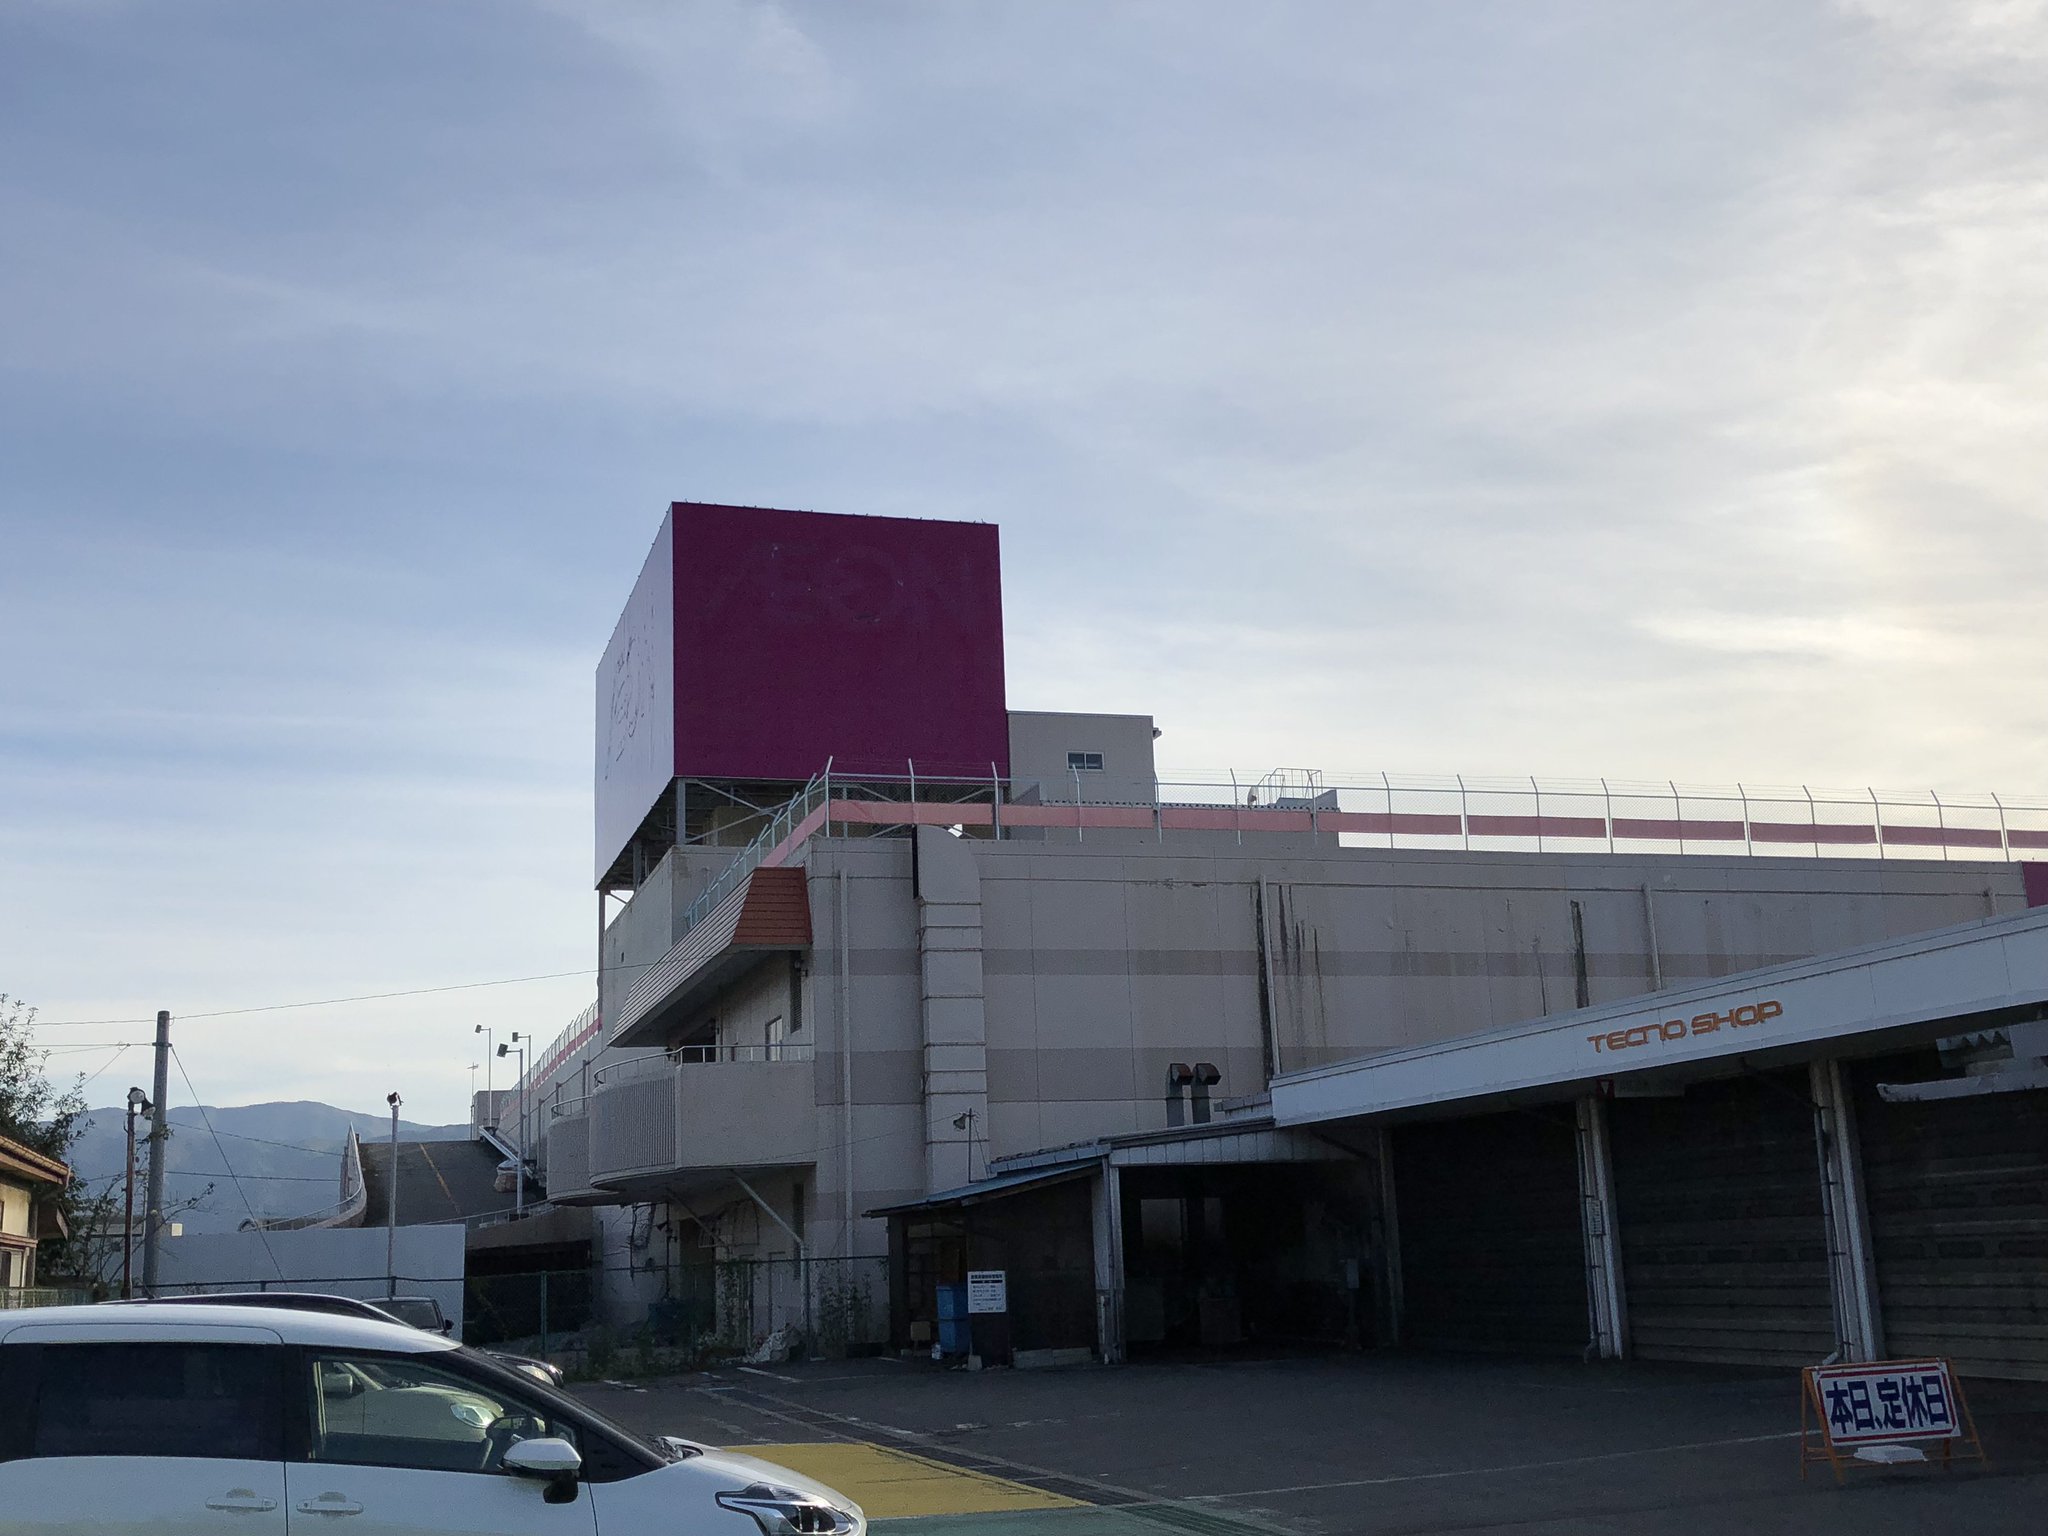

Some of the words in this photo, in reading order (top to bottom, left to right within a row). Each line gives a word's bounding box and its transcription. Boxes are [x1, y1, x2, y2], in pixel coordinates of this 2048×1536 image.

[1587, 1019, 1688, 1053] TECNO
[1691, 1000, 1783, 1036] SHOP
[1825, 1374, 1950, 1435] 本日、定休日
